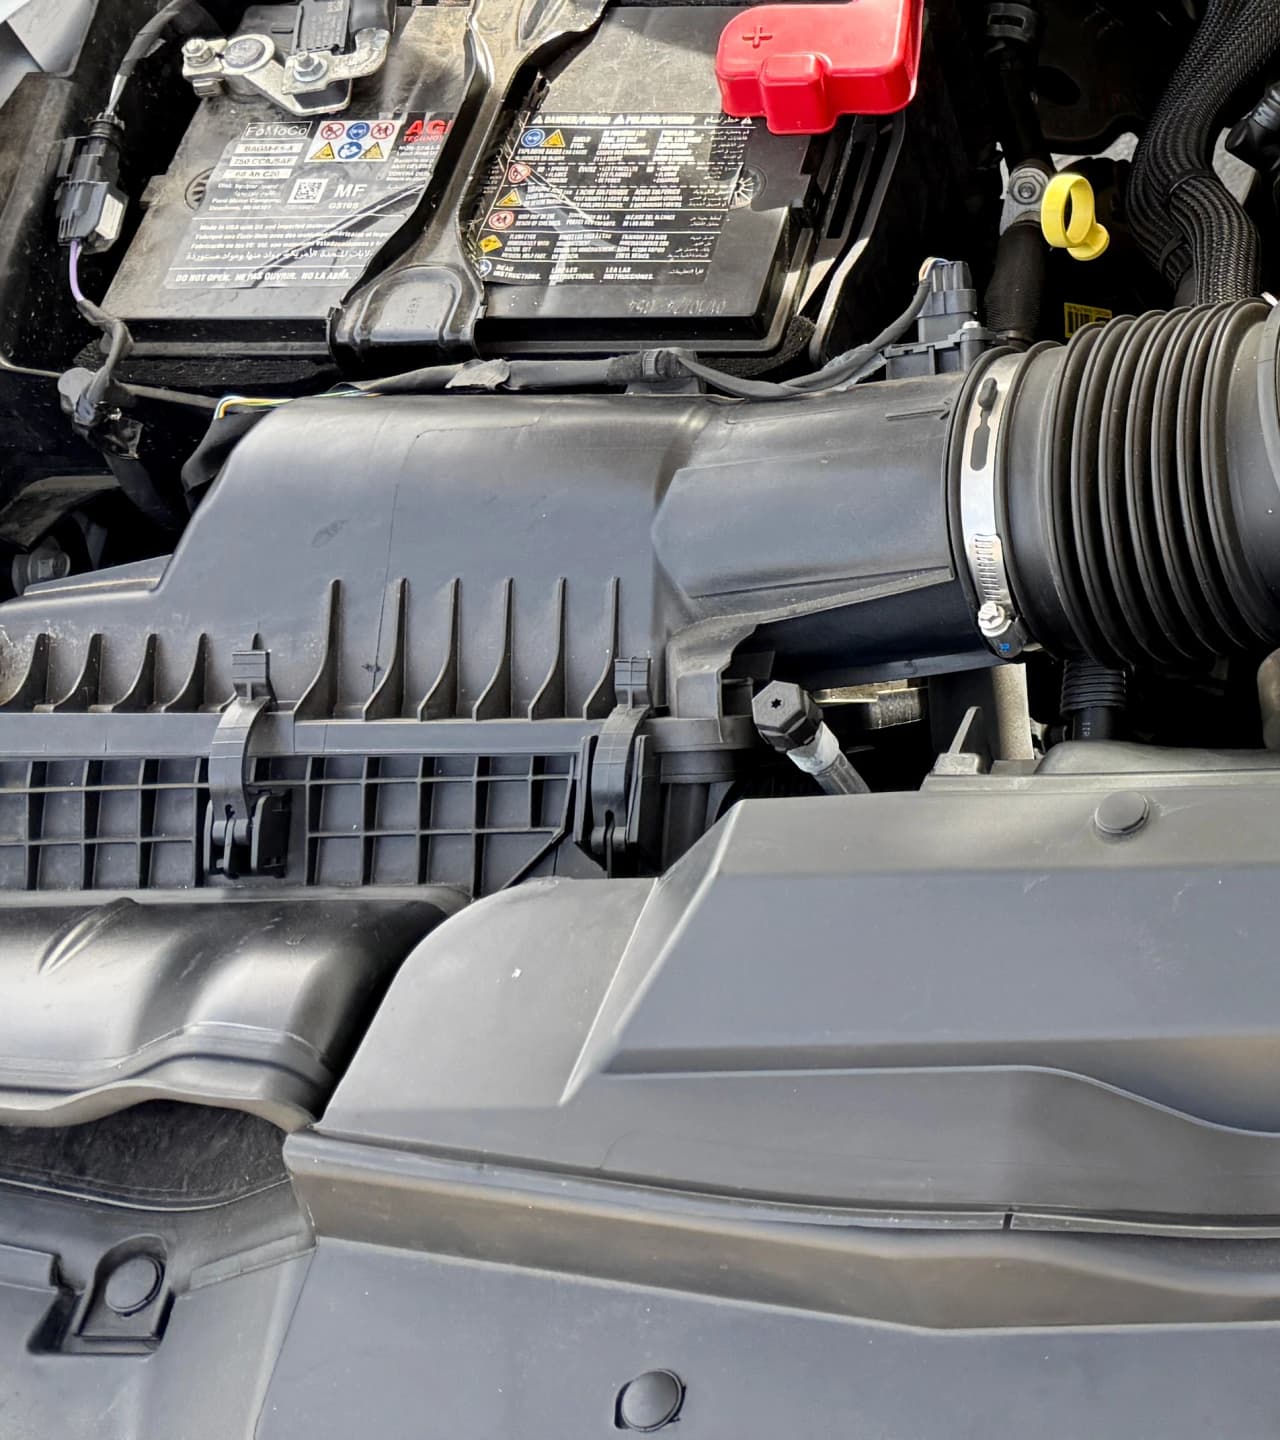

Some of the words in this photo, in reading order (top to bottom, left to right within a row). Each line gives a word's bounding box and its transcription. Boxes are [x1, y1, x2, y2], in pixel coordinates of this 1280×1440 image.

[334, 183, 368, 198] MF
[175, 274, 189, 282] DO
[189, 274, 206, 282] NOT
[206, 273, 233, 281] OPEN.
[301, 272, 313, 281] NO
[314, 272, 326, 281] LA
